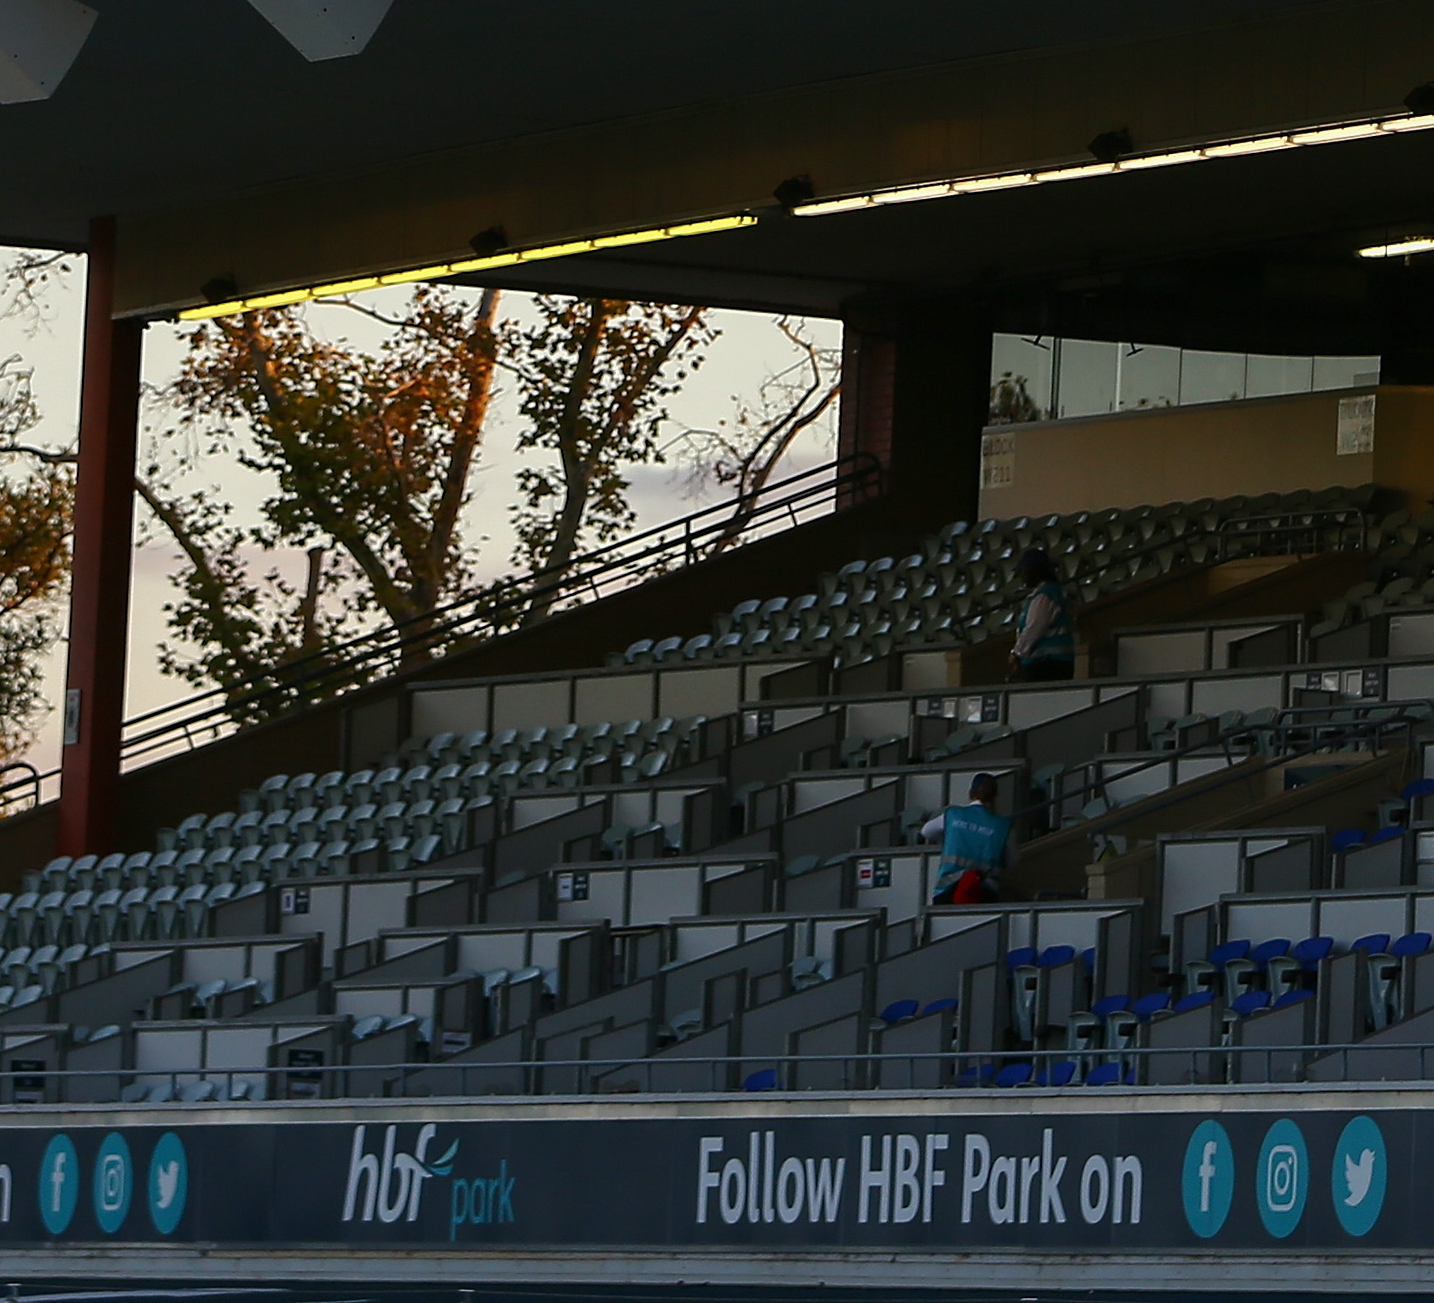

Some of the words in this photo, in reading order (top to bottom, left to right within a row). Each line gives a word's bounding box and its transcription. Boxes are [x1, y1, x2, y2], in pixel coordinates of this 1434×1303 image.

[341, 1123, 435, 1224] hbf
[450, 1158, 516, 1241] park
[697, 1131, 845, 1223] Follow
[859, 1134, 948, 1223] HBF
[962, 1129, 1067, 1224] Park
[1081, 1155, 1141, 1223] on
